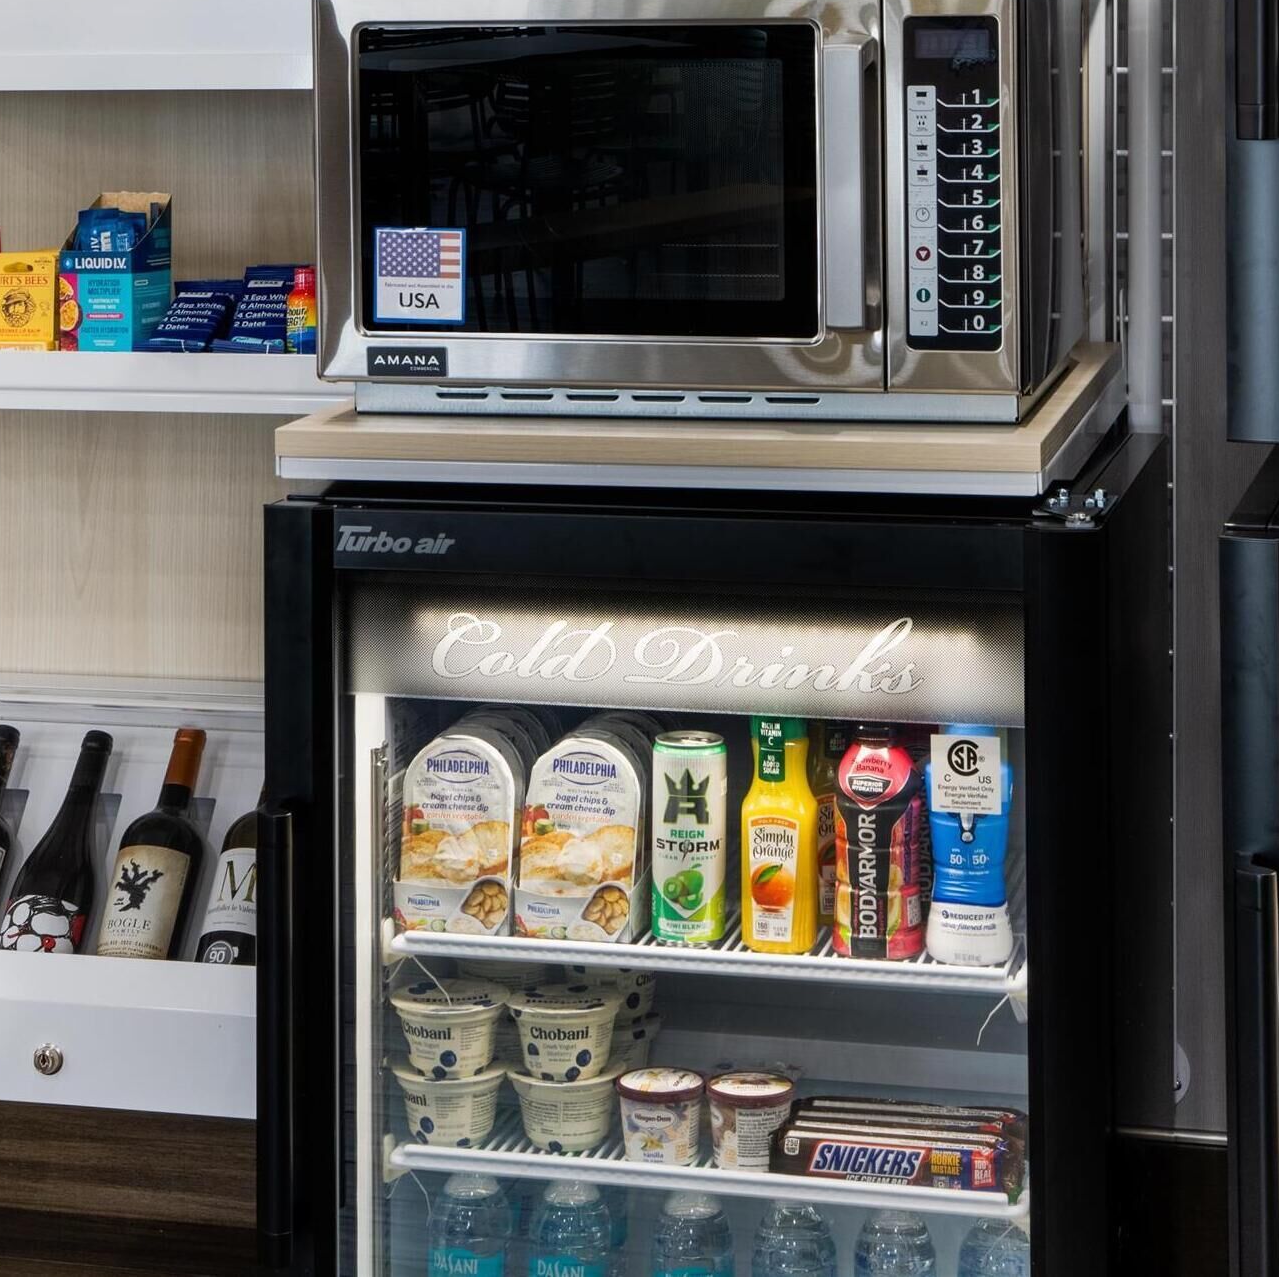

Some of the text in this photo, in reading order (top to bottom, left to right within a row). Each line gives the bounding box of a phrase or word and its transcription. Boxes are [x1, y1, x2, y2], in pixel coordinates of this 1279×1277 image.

[972, 89, 981, 103] 1
[972, 139, 983, 154] 3
[973, 190, 983, 204] 5
[972, 215, 984, 230] 6
[973, 240, 984, 254] 7
[75, 258, 113, 269] LIQUID
[973, 265, 984, 280] 8
[399, 292, 439, 309] USA
[973, 290, 984, 304] 9
[973, 315, 985, 330] 0
[374, 355, 439, 365] AMANA
[426, 758, 490, 775] PHILADELPHIA
[856, 764, 884, 774] Banana
[944, 774, 951, 782] C
[982, 785, 994, 793] Only
[430, 792, 482, 803] bagel chips &
[444, 802, 473, 811] cheese
[474, 802, 489, 813] dip
[670, 829, 705, 839] REIGN
[753, 827, 794, 847] Simply
[657, 838, 721, 852] STORM
[753, 843, 794, 861] Orange
[859, 813, 877, 938] BODYARMOR
[107, 918, 151, 931] BOGLE
[209, 951, 225, 962] 90
[530, 1026, 590, 1041] Chobani
[814, 1143, 921, 1175] SNICKERS
[974, 1170, 992, 1180] REAL
[434, 1252, 478, 1275] DASANI
